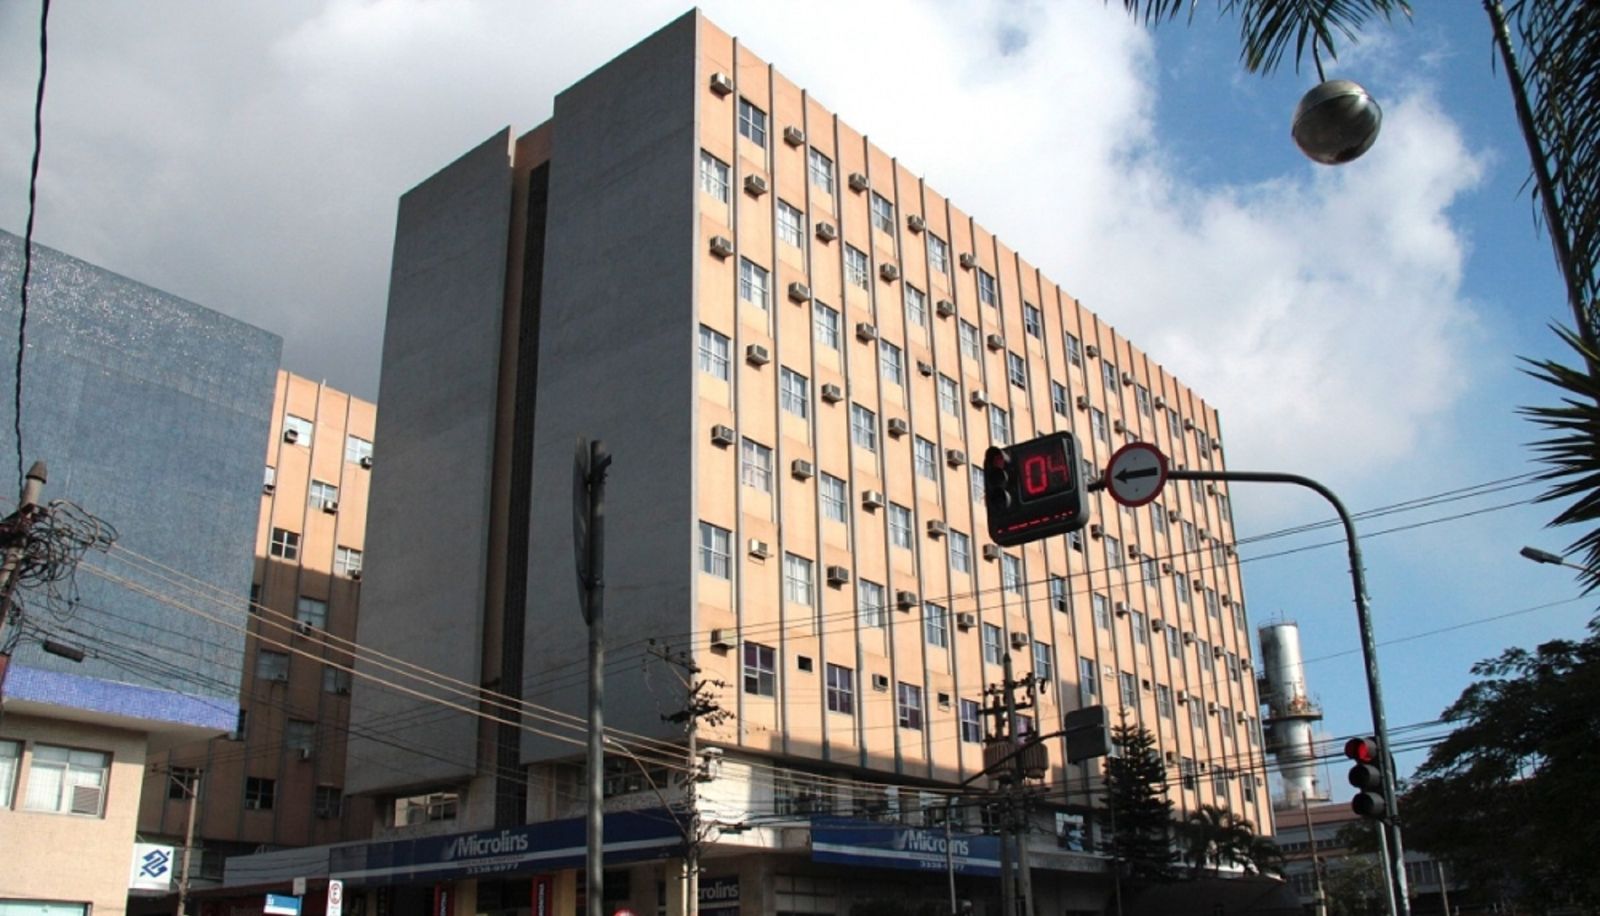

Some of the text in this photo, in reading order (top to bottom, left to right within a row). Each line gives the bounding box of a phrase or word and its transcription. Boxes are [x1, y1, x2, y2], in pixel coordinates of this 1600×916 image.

[1024, 447, 1070, 495] 04
[457, 829, 529, 857] Microlins
[908, 829, 969, 856] Microins
